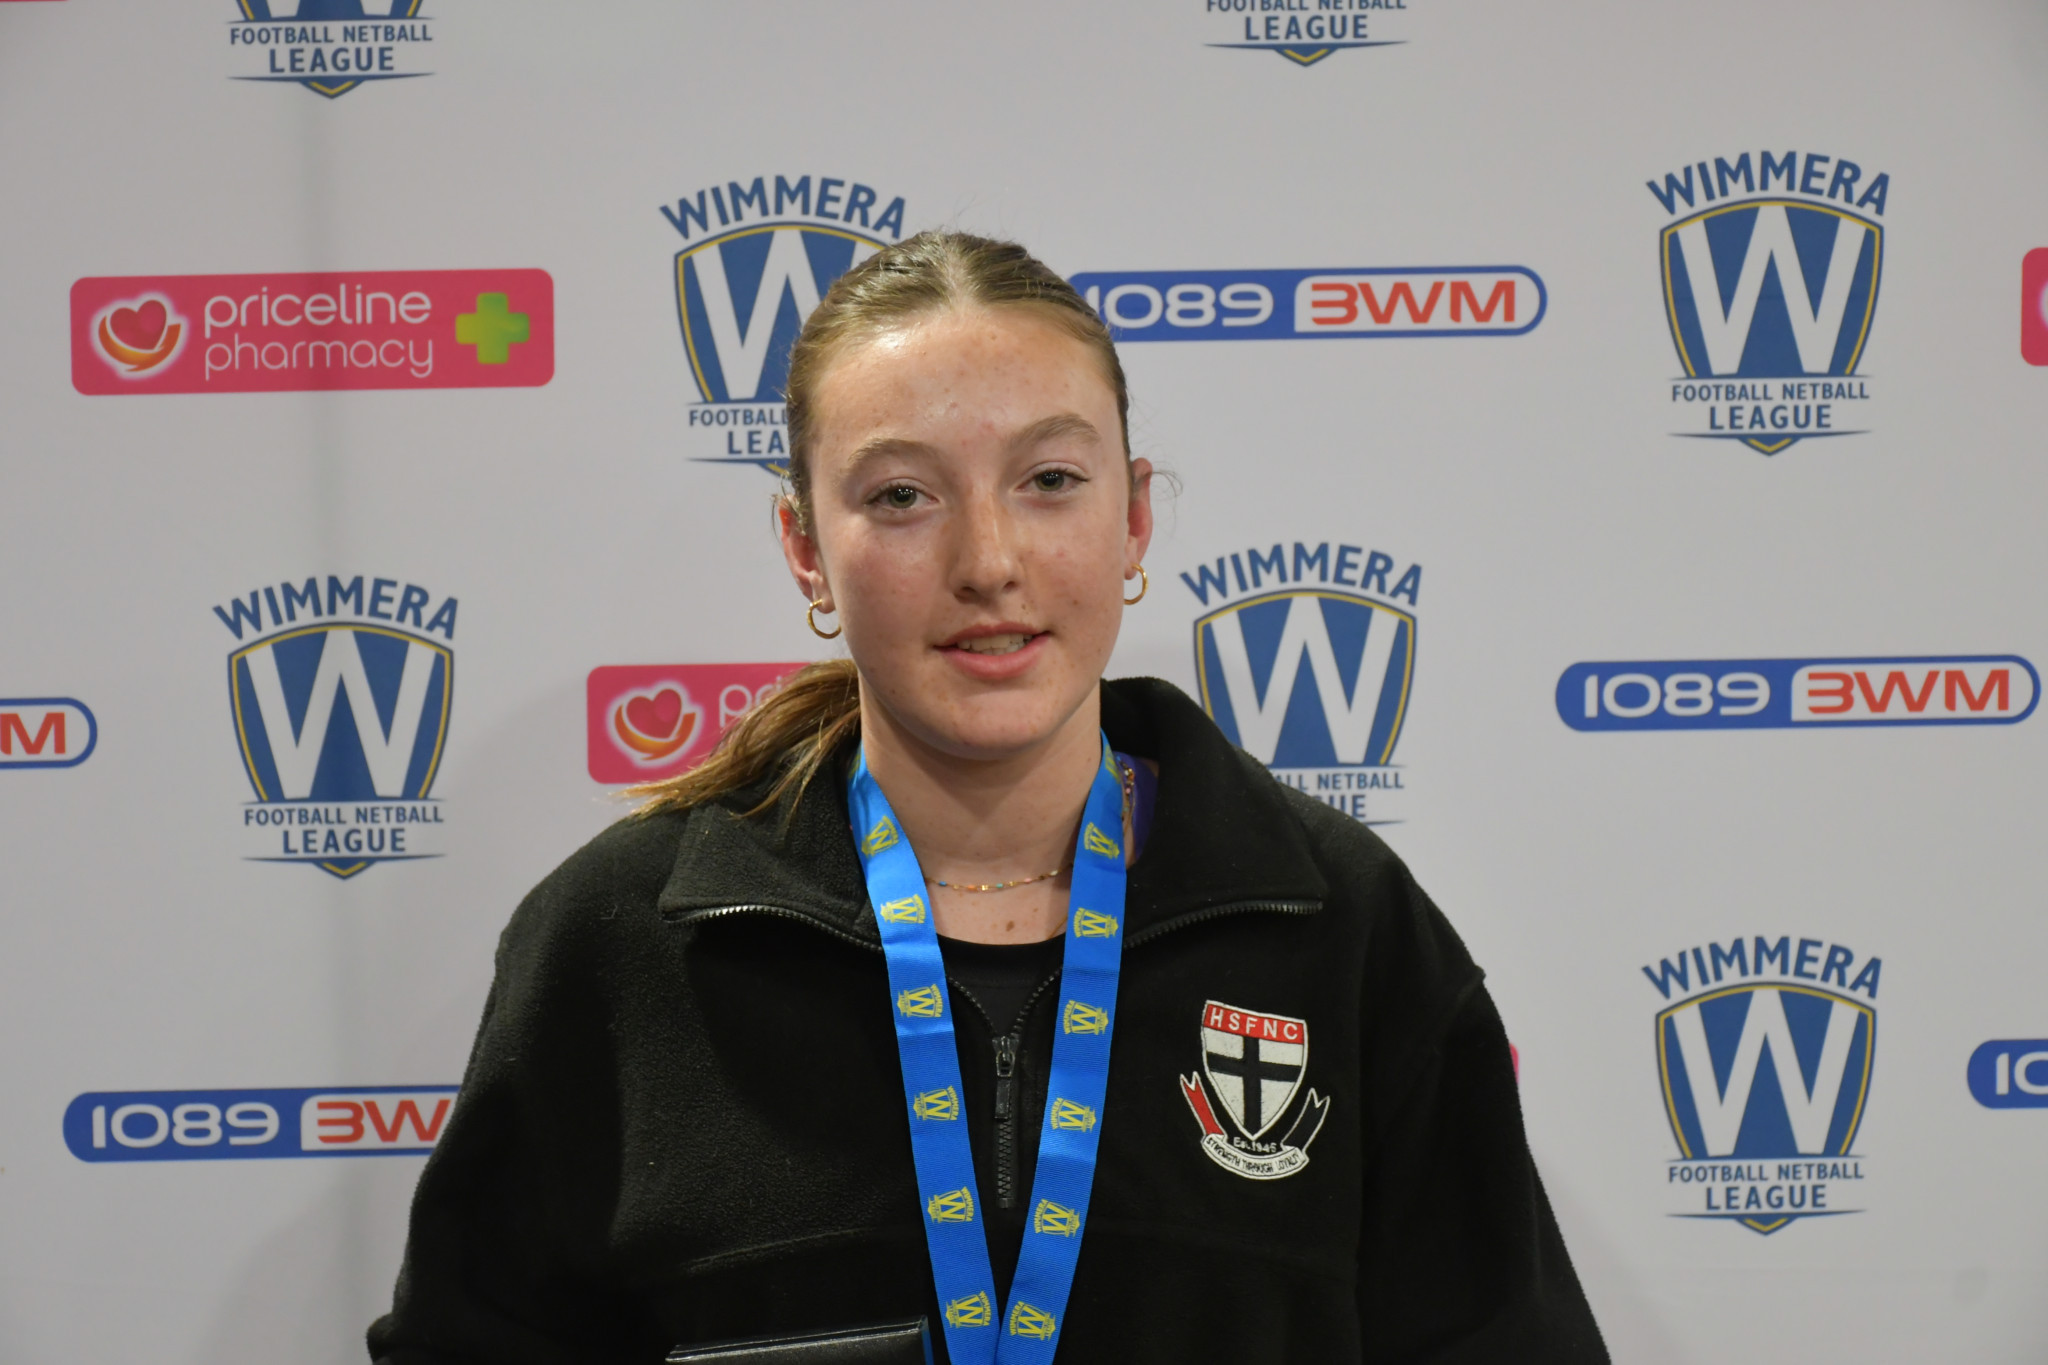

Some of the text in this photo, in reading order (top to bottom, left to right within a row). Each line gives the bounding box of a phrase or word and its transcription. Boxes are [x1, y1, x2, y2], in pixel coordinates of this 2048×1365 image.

[1207, 0, 1407, 12] FOOTBALL NETBALL
[231, 25, 432, 44] FOOTBALL NETBALL
[1246, 15, 1367, 40] LEAGUE
[270, 47, 393, 73] LEAGUE
[1646, 151, 1889, 216] WIMMERA
[659, 175, 906, 240] WIMMERA
[1311, 280, 1516, 325] 3WM
[1676, 206, 1867, 375] W
[205, 283, 432, 338] priceline
[205, 334, 433, 381] pharmacy
[1673, 383, 1869, 401] FOOTBALL NETBALL
[1710, 405, 1830, 430] LEAGUE
[728, 430, 785, 455] LEA
[1180, 542, 1422, 606] WIMMERA
[213, 575, 458, 640] WIMMERA
[1585, 669, 2009, 717] 1089 3WM
[245, 630, 436, 799] W
[1317, 772, 1404, 789] NETBALL
[245, 807, 443, 825] FOOTBALL NETBALL
[283, 829, 405, 854] LEAGUE
[1642, 936, 1881, 1000] WIMMERA
[930, 984, 943, 1017] WIMMERA
[1063, 1000, 1075, 1034] WIMMERA
[1210, 1007, 1298, 1040] HSFNC
[1672, 989, 1859, 1157] W
[1996, 1052, 2048, 1095] 10
[946, 1085, 958, 1121] WIMMERA
[1051, 1098, 1063, 1129] WIMMERA
[93, 1099, 451, 1148] 1089 3W
[1669, 1163, 1863, 1182] FOOTBALL NETBALL
[962, 1187, 973, 1222] WIMMERA
[1707, 1185, 1826, 1210] LEAGUE
[1034, 1199, 1048, 1233] WIMMERA
[979, 1291, 991, 1326] WIMMERA
[1009, 1301, 1024, 1336] WIMMERA
